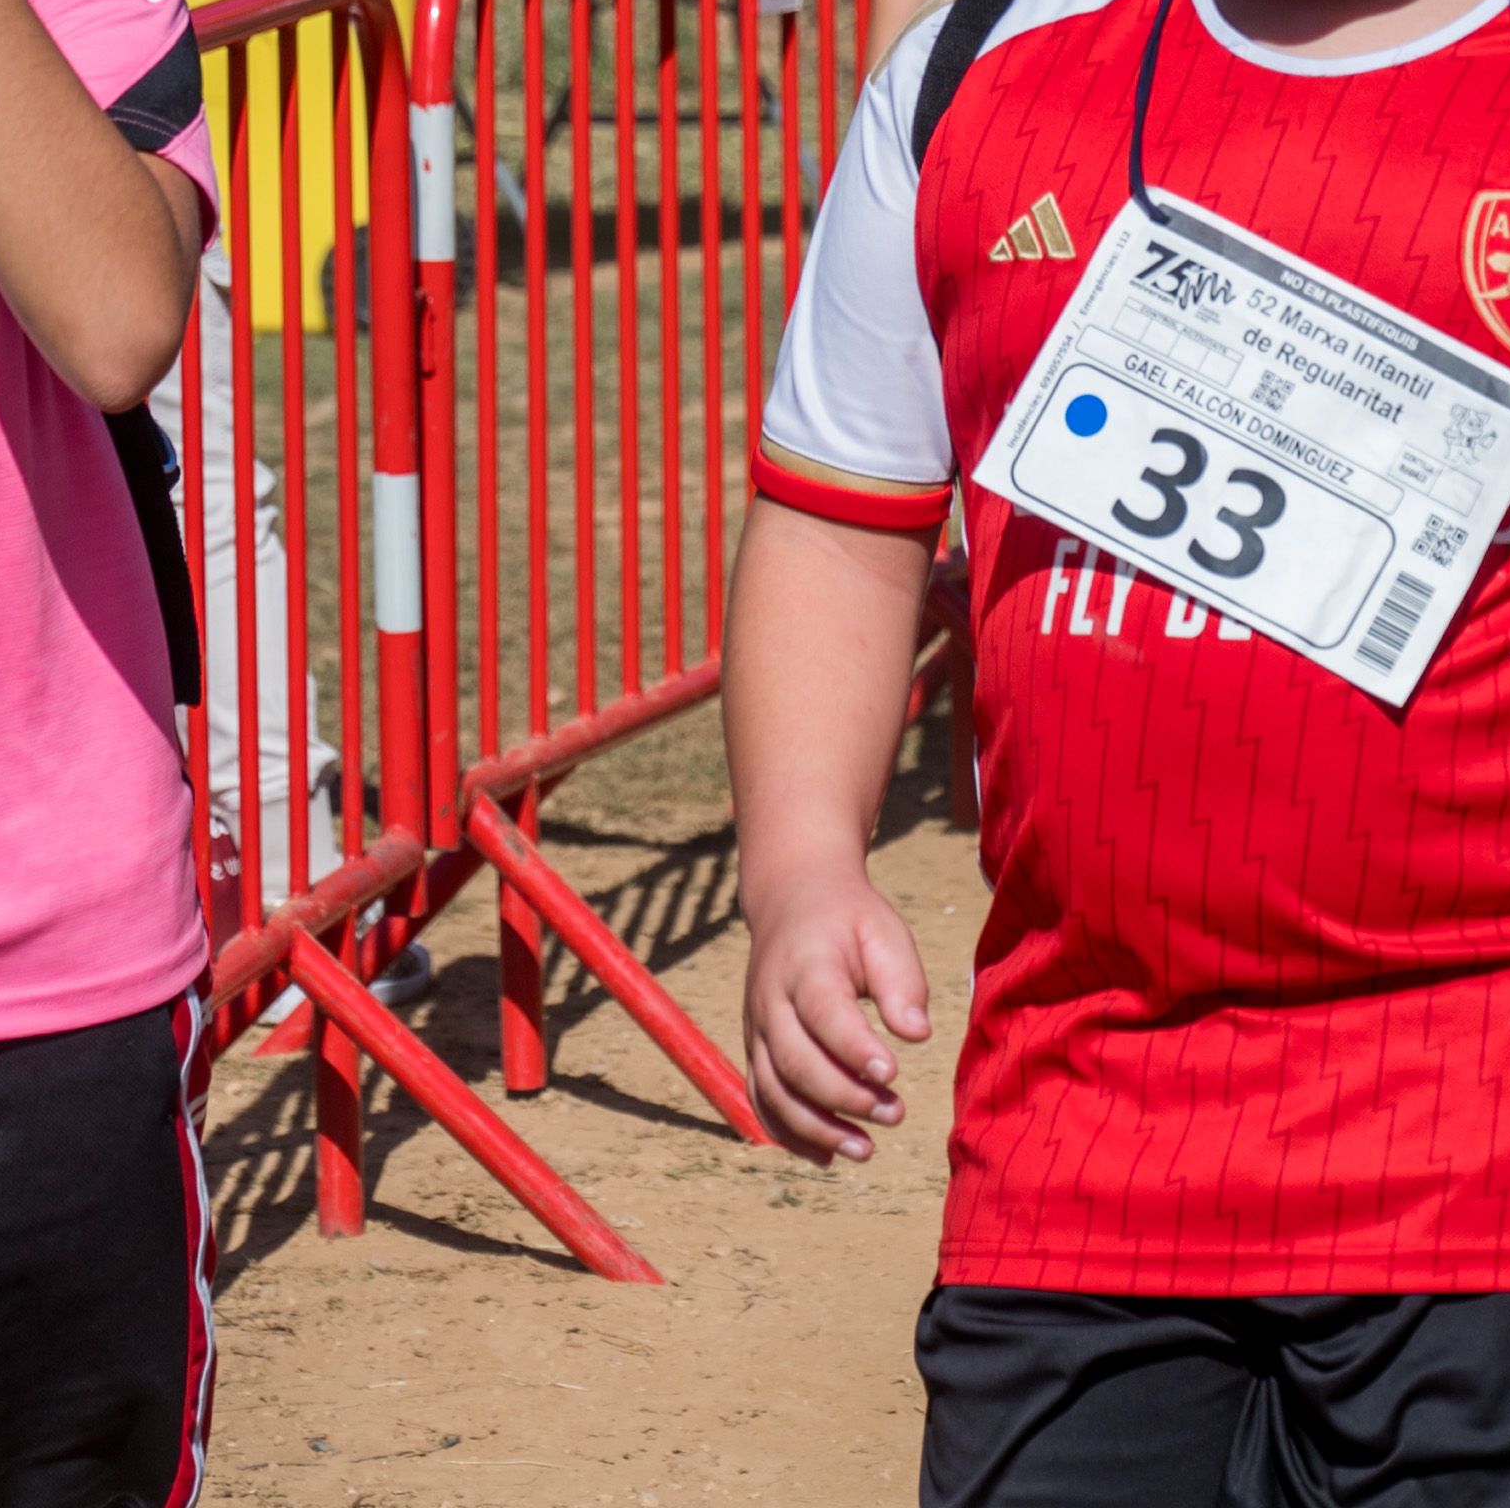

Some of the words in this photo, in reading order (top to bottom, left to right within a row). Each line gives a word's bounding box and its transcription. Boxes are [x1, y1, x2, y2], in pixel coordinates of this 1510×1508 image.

[1116, 230, 1132, 249] 112
[1246, 288, 1279, 318] 52
[1278, 305, 1349, 356] Marxa
[1352, 344, 1435, 401] Infantil
[1279, 269, 1305, 291] NO
[1302, 282, 1326, 303] EM
[1324, 293, 1420, 352] PLASTIFIQUIS
[1124, 353, 1168, 390] GAEL
[1172, 378, 1247, 427] FALCÓN
[1246, 416, 1355, 486] DOMINGUEZ
[1242, 327, 1273, 353] de
[1275, 342, 1404, 425] Regularitat
[1110, 427, 1287, 580] 33
[1041, 537, 1139, 637] FLY
